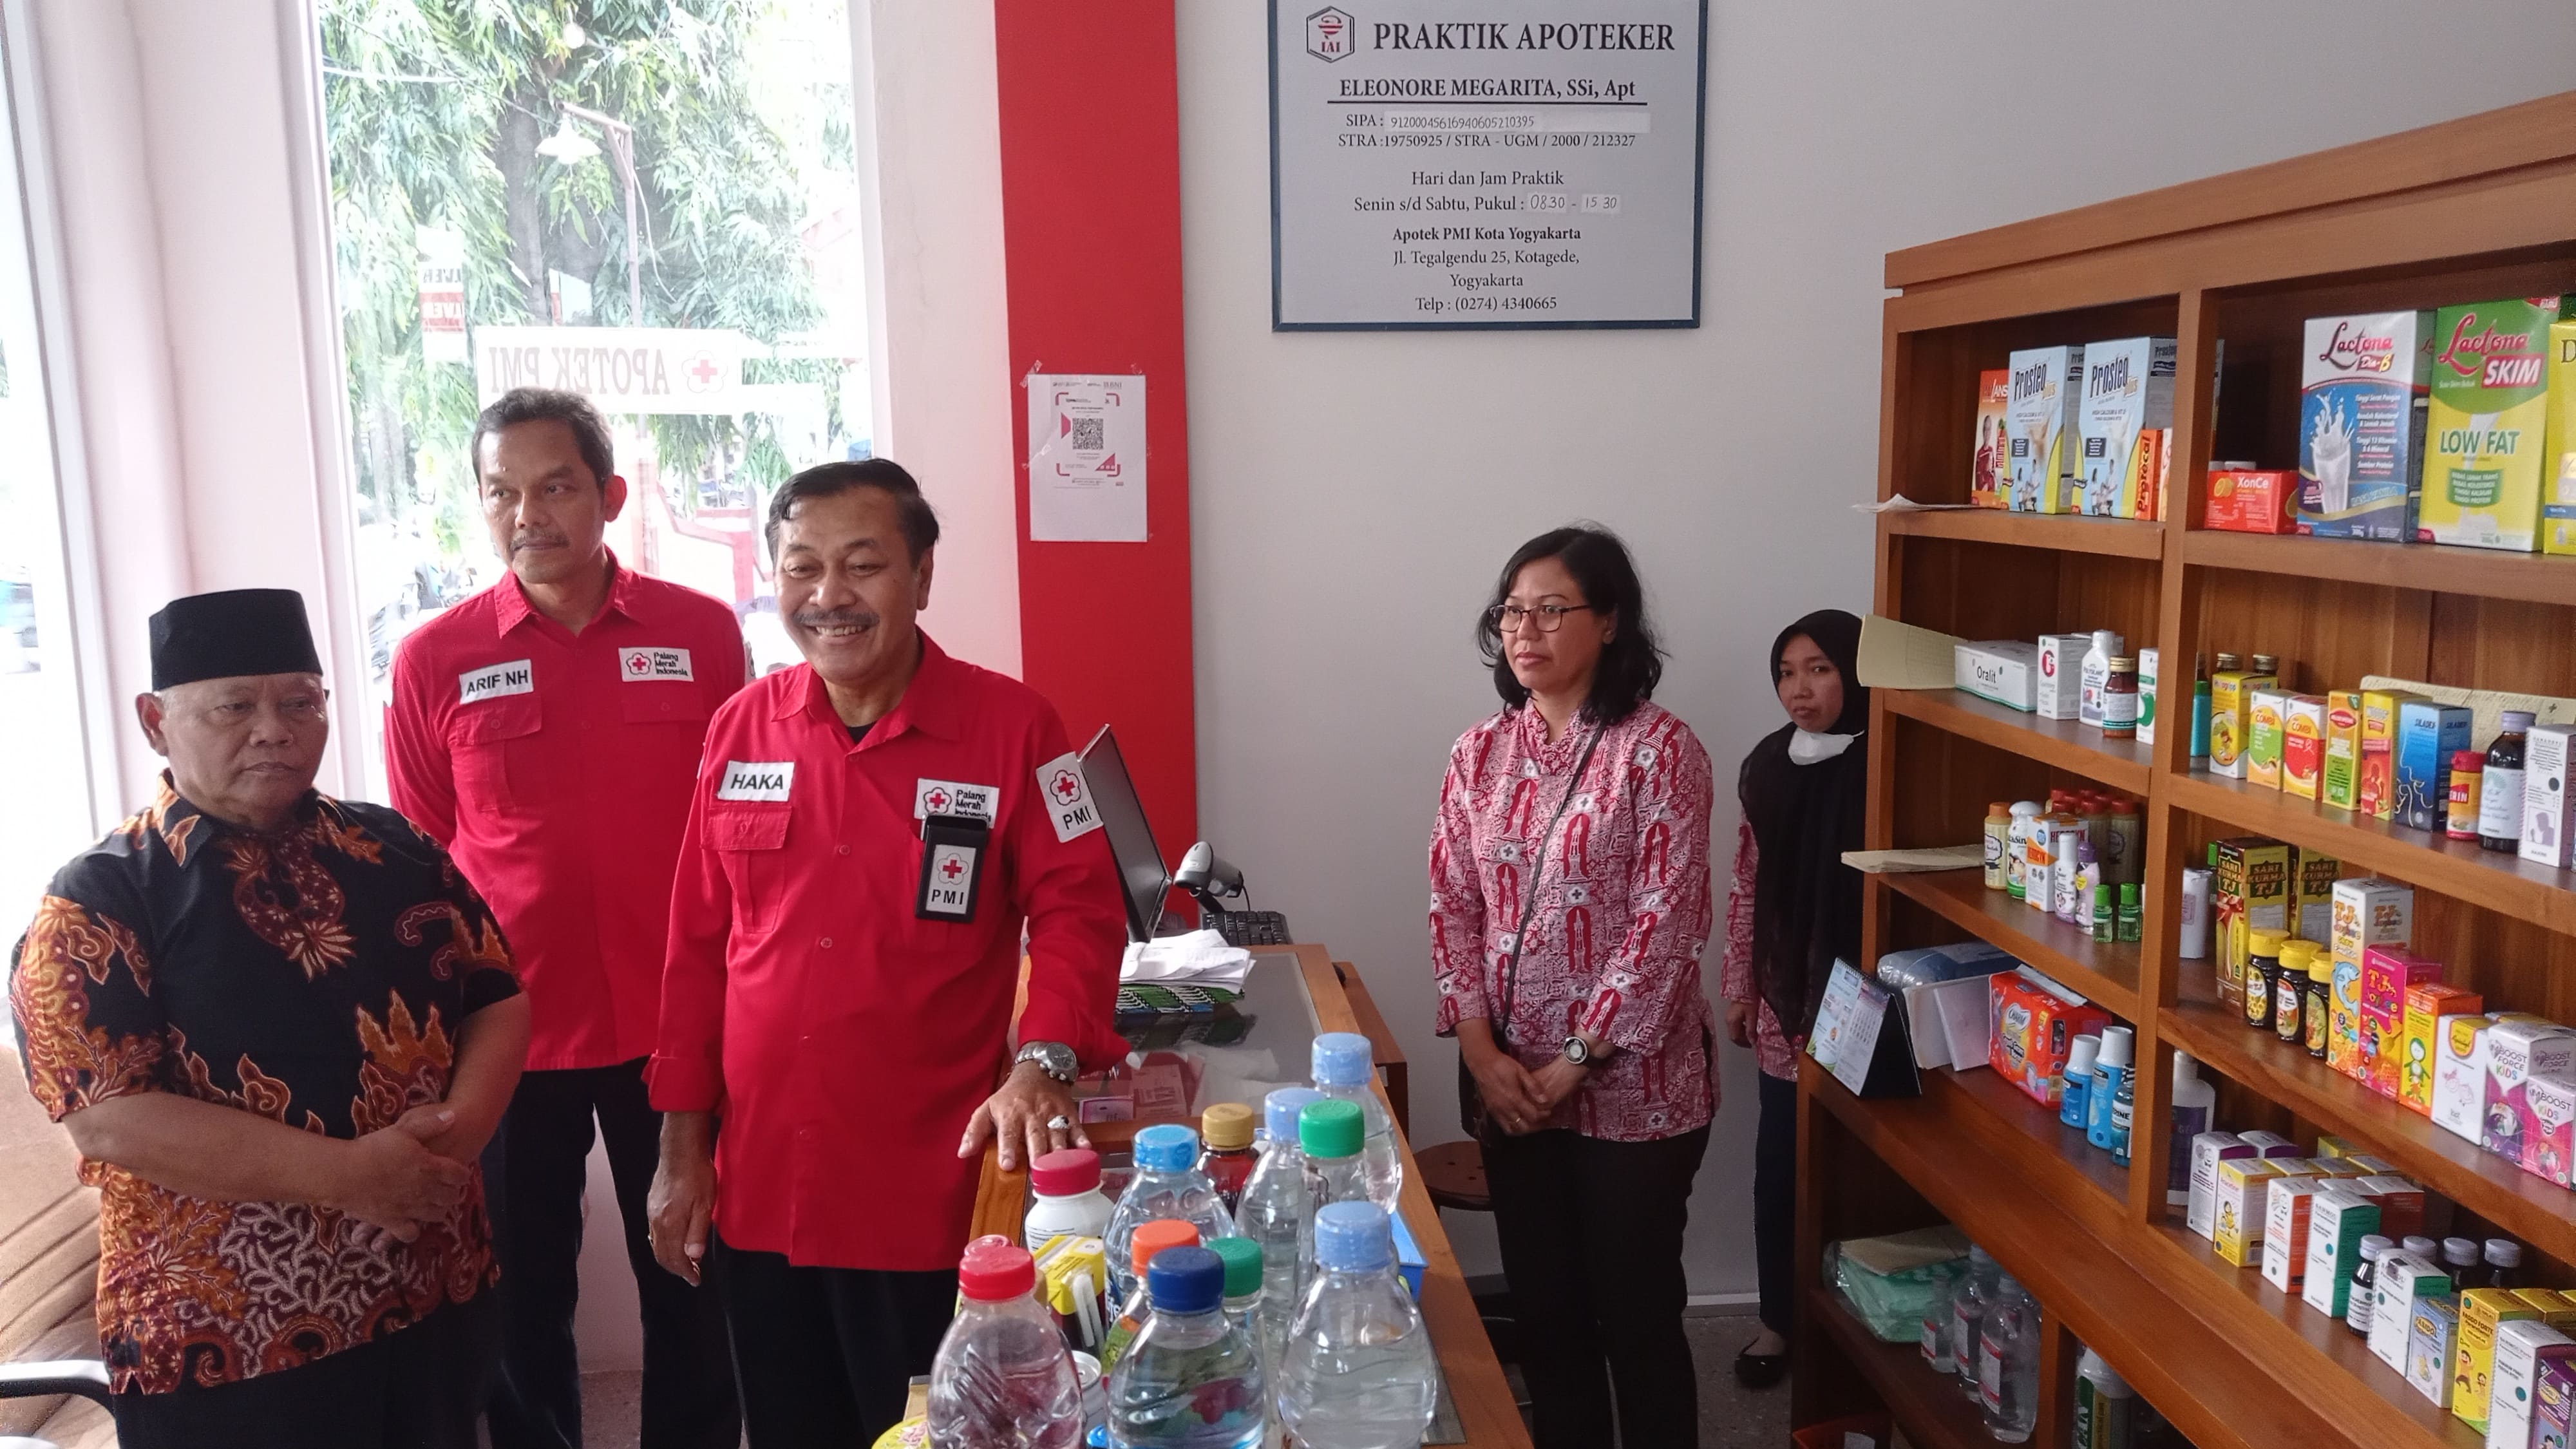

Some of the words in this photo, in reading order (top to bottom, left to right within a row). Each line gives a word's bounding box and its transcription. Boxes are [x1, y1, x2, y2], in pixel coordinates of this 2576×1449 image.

[1374, 23, 1508, 50] PRAKTIK
[1516, 24, 1675, 50] APOTEKER
[1321, 41, 1341, 53] IAI
[1340, 79, 1445, 96] ELEONORE
[1451, 79, 1561, 99] MEGARITA,
[1566, 79, 1598, 99] SSi,
[1604, 80, 1635, 100] Apt
[1346, 114, 1378, 126] SIPA
[1454, 135, 1490, 147] STRA
[1504, 135, 1539, 147] UGM
[1551, 135, 1580, 147] 2000
[1592, 135, 1636, 147] 212327
[1412, 171, 1444, 185] Hari
[1448, 170, 1475, 185] dan
[1479, 171, 1507, 187] Jam
[1511, 170, 1564, 185] Praktik
[1354, 196, 1395, 211] Senin
[1399, 196, 1421, 211] s/d
[1426, 196, 1470, 213] Sabtu,
[1474, 196, 1517, 211] Pukul
[1393, 227, 1439, 243] Apotek
[1443, 227, 1471, 240] PMI
[1475, 227, 1505, 240] Kota
[1508, 227, 1582, 243] Yogyakarta
[1393, 251, 1407, 266] Jl.
[1411, 250, 1487, 267] Tegalgendu
[1491, 251, 1511, 265] 25,
[1515, 249, 1580, 267] Kotagede,
[1450, 274, 1524, 290] Yogyakarta
[1415, 298, 1443, 313] Telp
[1455, 297, 1498, 312] (0274)
[1502, 298, 1557, 310] 4340665
[2320, 322, 2392, 370] Lactona
[2438, 313, 2530, 376] Lactona
[2090, 356, 2128, 399] Prosteo
[2483, 358, 2542, 386] SKIM
[2440, 431, 2482, 455] LOW
[2486, 430, 2521, 455] FAT
[2237, 477, 2269, 488] XonCe
[654, 652, 679, 663] Palang
[654, 660, 677, 668] Merah
[656, 667, 689, 677] Indonesia
[1977, 665, 1996, 684] Oralit
[466, 674, 501, 696] ARIF
[506, 669, 529, 687] NH
[730, 774, 784, 790] HAKA
[956, 790, 986, 802] Palang
[956, 799, 982, 811] Merah
[1063, 806, 1093, 831] PMI
[2222, 860, 2238, 872] SARI
[2254, 864, 2280, 873] SARI
[2222, 879, 2237, 892] TJ
[2256, 883, 2278, 895] TJ
[931, 889, 965, 905] PMI
[2498, 1055, 2525, 1072] FORCE
